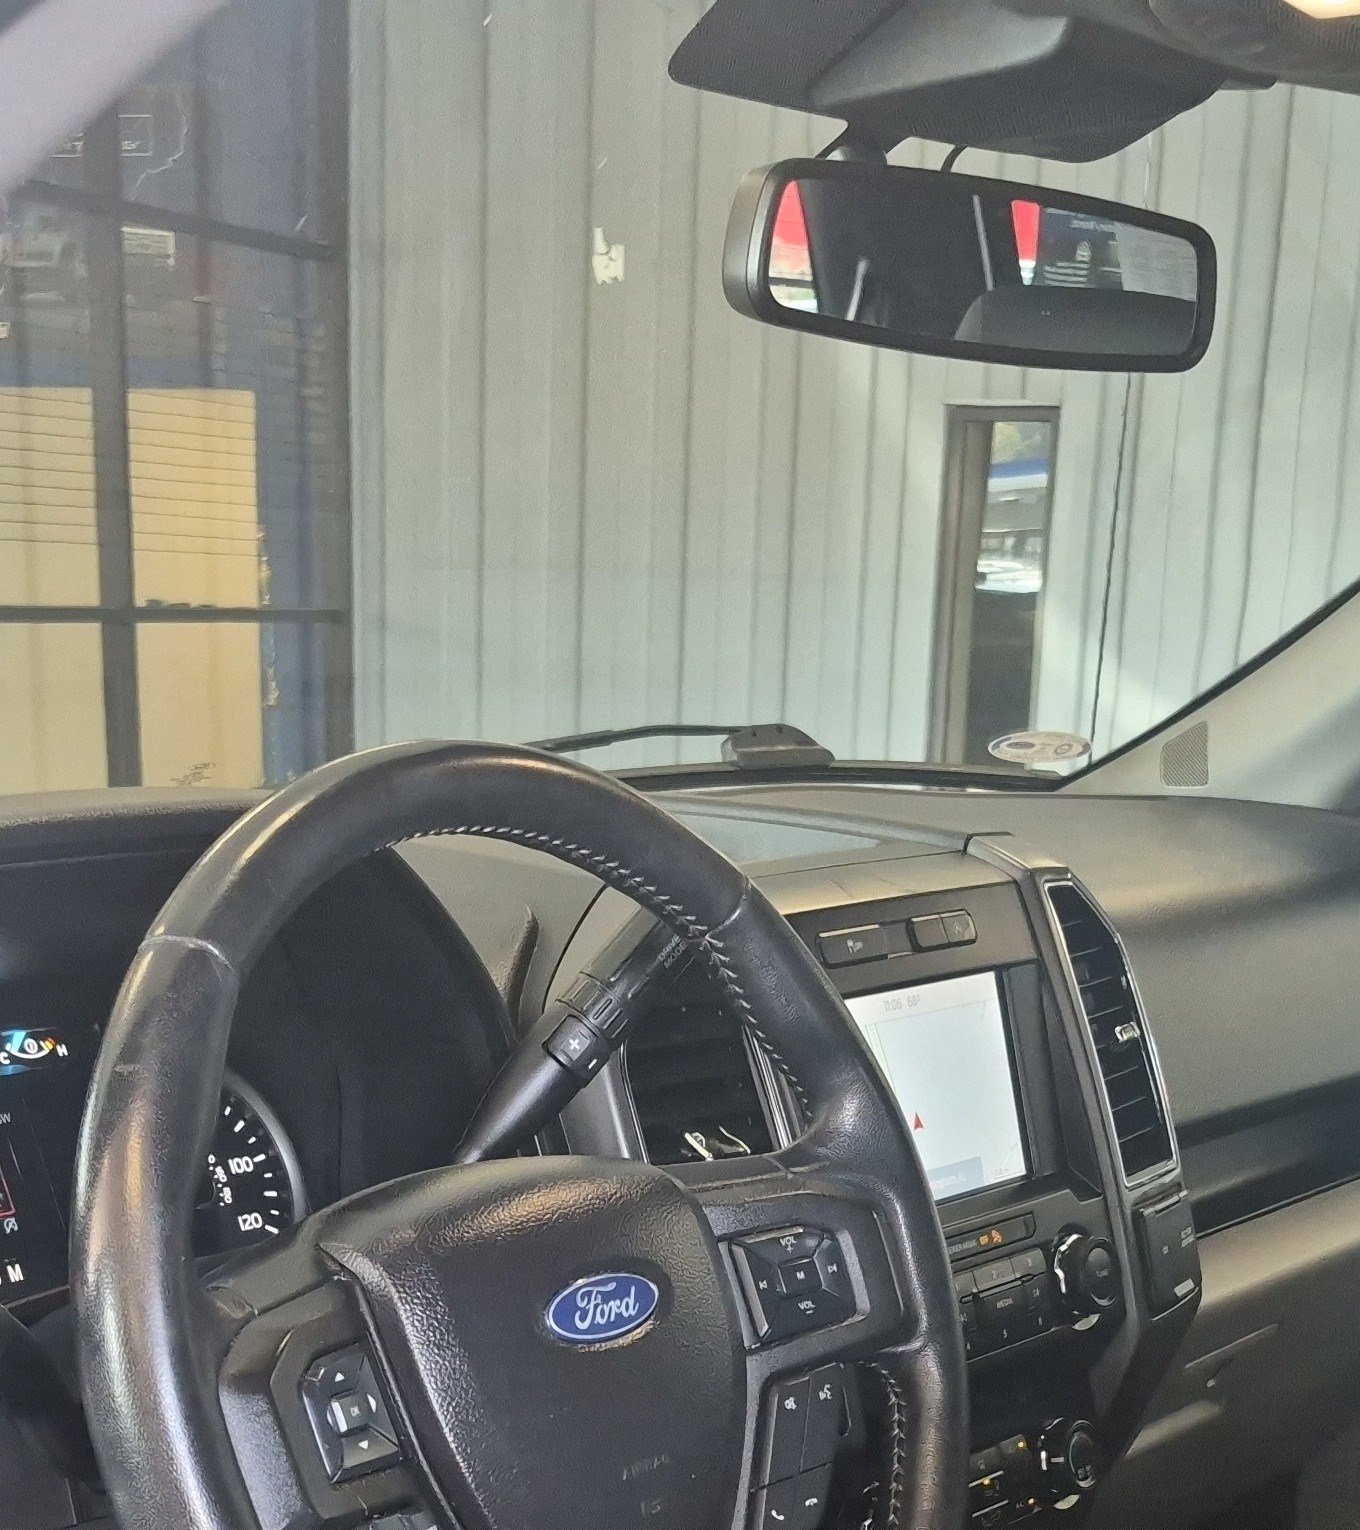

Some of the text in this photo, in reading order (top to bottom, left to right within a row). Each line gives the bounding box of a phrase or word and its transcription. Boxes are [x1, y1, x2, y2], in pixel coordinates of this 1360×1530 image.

[56, 1044, 69, 1057] H
[228, 1155, 254, 1175] 100
[237, 1212, 263, 1232] 120
[780, 1235, 797, 1247] VOL
[6, 1263, 24, 1283] M
[574, 1281, 640, 1330] Ford
[797, 1300, 816, 1311] VOL
